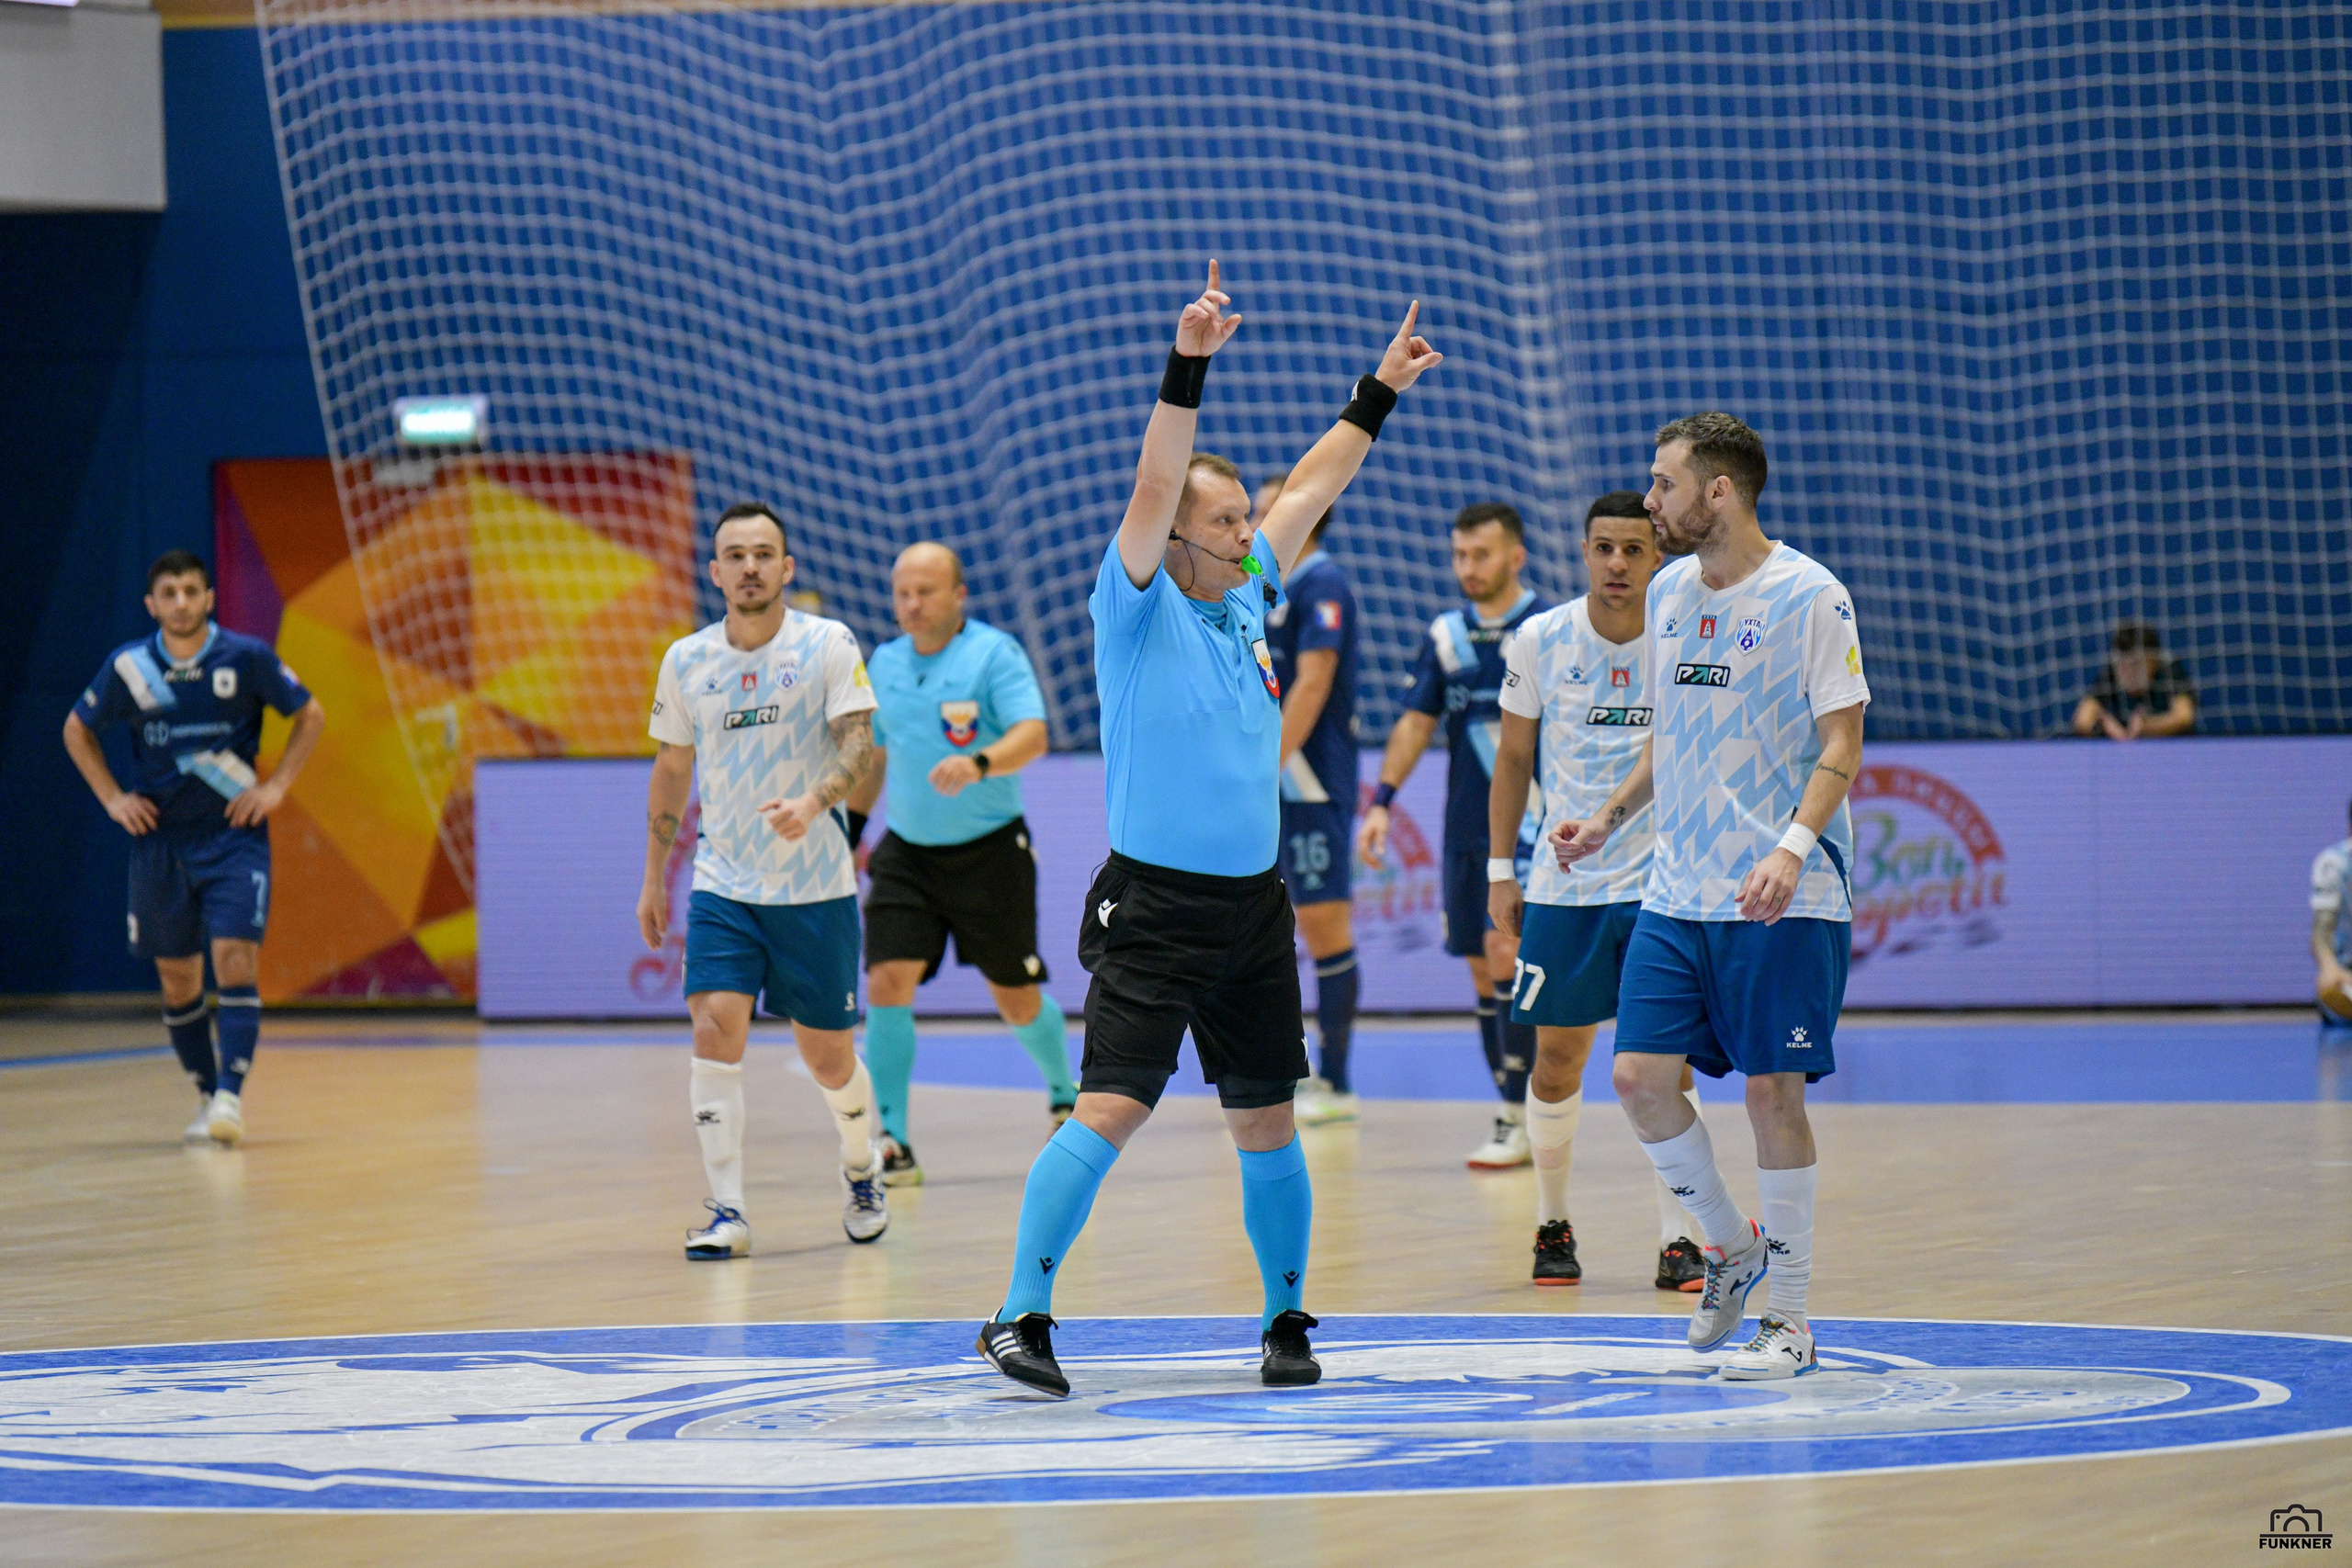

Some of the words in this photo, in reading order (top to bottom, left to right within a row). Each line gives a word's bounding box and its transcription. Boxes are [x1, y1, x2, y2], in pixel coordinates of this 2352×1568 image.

[1745, 618, 1761, 628] УХТА
[1677, 665, 1729, 685] PARI
[726, 706, 779, 728] PARI
[1589, 708, 1652, 725] PARI
[1289, 831, 1331, 873] 16
